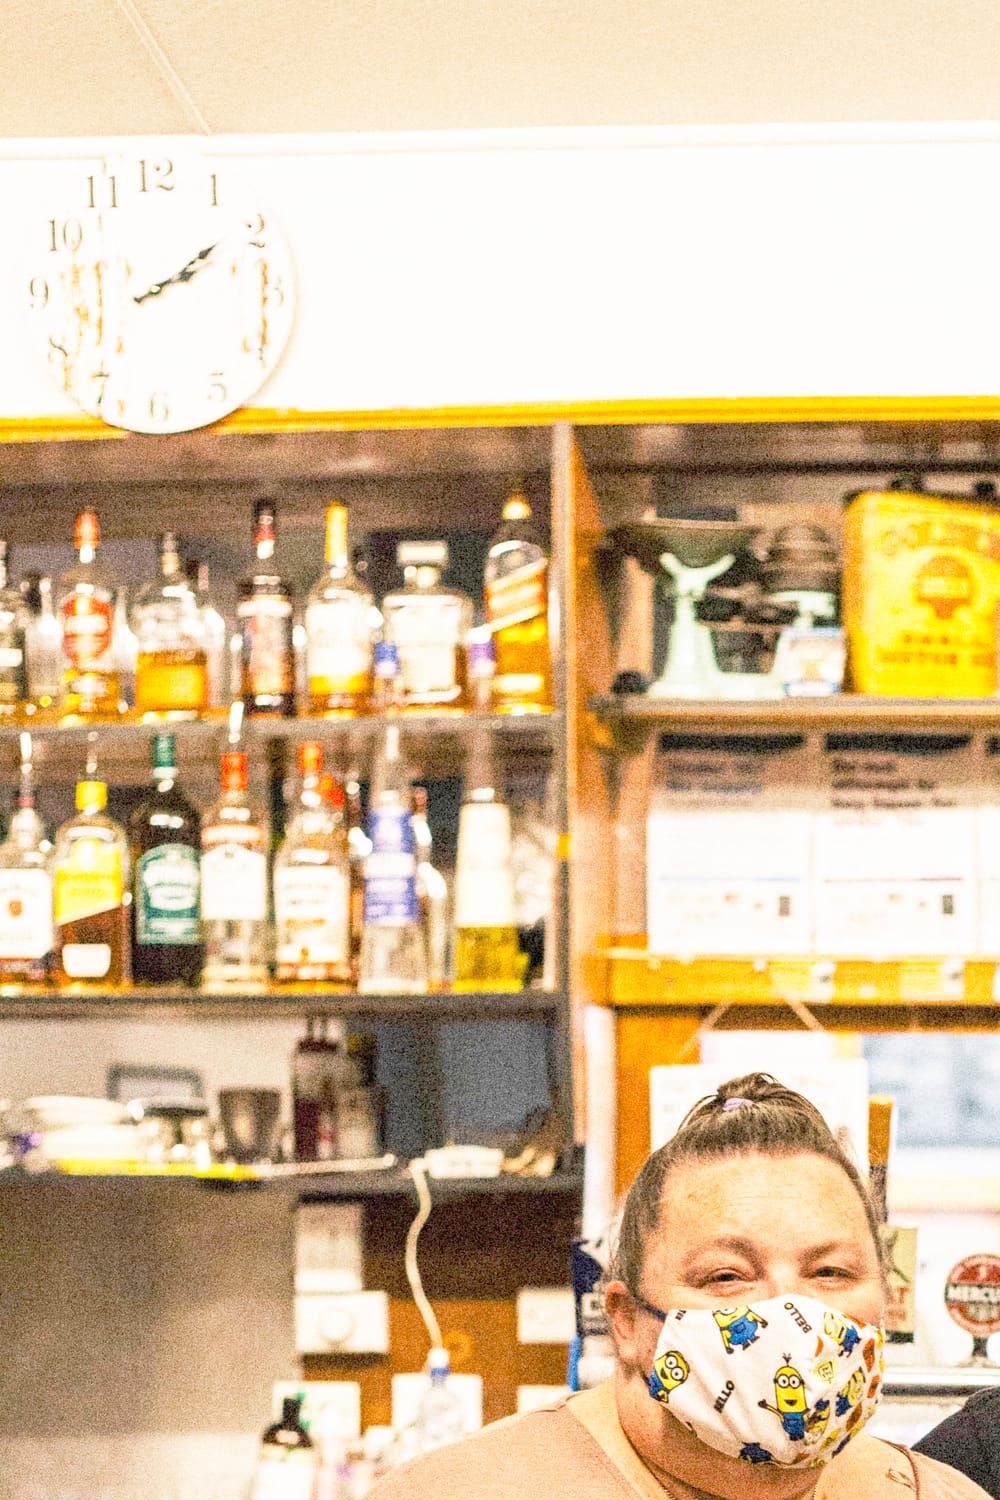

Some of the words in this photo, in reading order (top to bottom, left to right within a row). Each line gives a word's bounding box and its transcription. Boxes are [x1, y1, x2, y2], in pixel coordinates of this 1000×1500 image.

[87, 175, 118, 208] 11
[138, 159, 174, 192] 12
[209, 173, 219, 207] 1
[48, 217, 83, 252] 10
[245, 212, 266, 249] 2
[29, 276, 49, 310] 9
[91, 370, 110, 405] 7
[208, 371, 228, 401] 5
[149, 391, 170, 422] 6
[783, 1302, 813, 1335] BELLO
[713, 1379, 736, 1414] HELLO
